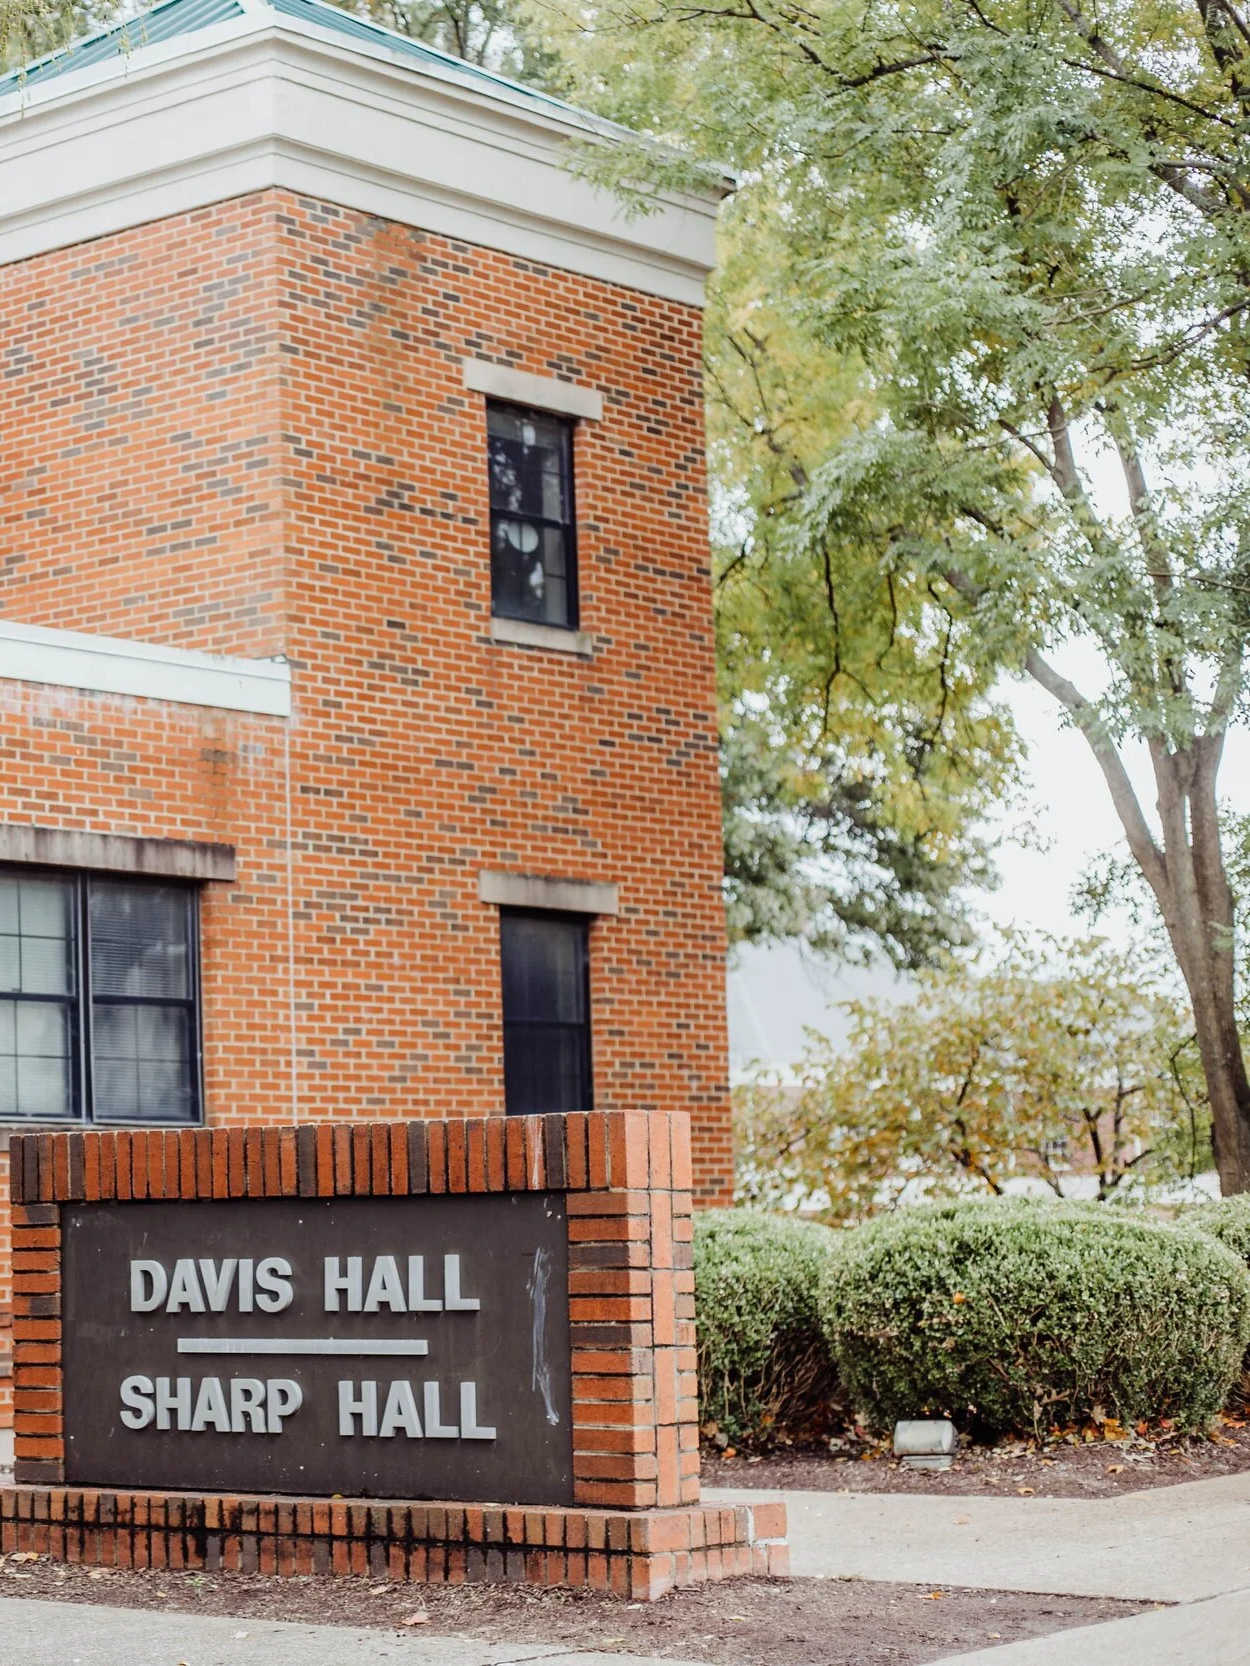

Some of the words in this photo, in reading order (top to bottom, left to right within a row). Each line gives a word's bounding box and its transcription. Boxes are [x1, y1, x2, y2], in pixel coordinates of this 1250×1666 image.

[130, 1257, 294, 1313] DAVIS
[324, 1254, 481, 1312] HALL
[120, 1375, 303, 1434] SHARP
[338, 1380, 497, 1439] HALL
